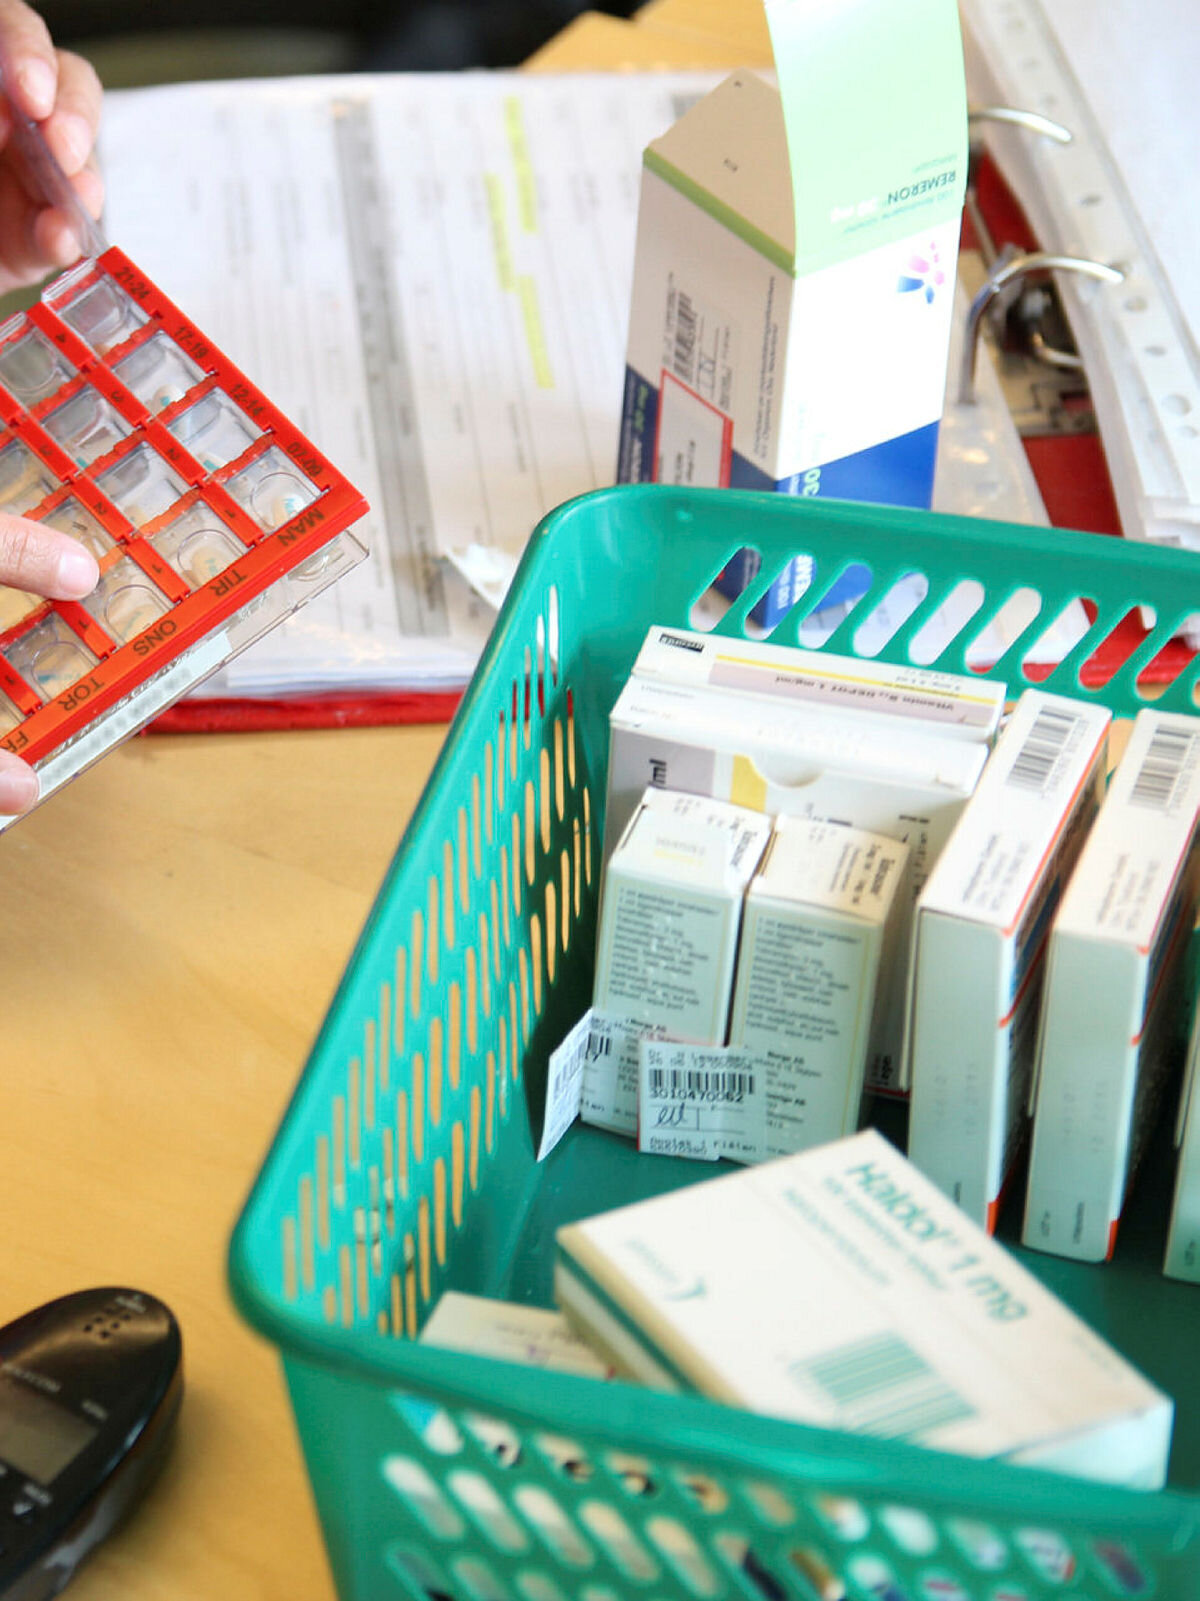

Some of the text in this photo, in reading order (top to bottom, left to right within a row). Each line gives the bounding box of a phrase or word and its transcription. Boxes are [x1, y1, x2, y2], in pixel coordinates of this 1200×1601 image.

[887, 169, 957, 205] REMERON
[115, 266, 151, 300] 21-24
[174, 325, 210, 359] 17-19
[230, 383, 265, 416] 12-14
[803, 467, 822, 498] 30
[277, 508, 325, 547] MAN
[209, 569, 248, 597] TIR
[133, 620, 178, 656] ONS
[57, 676, 105, 712] TOR
[2, 730, 29, 753] FR
[845, 1162, 954, 1243] Haldol
[949, 1253, 982, 1274] 1
[964, 1273, 1029, 1322] mg
